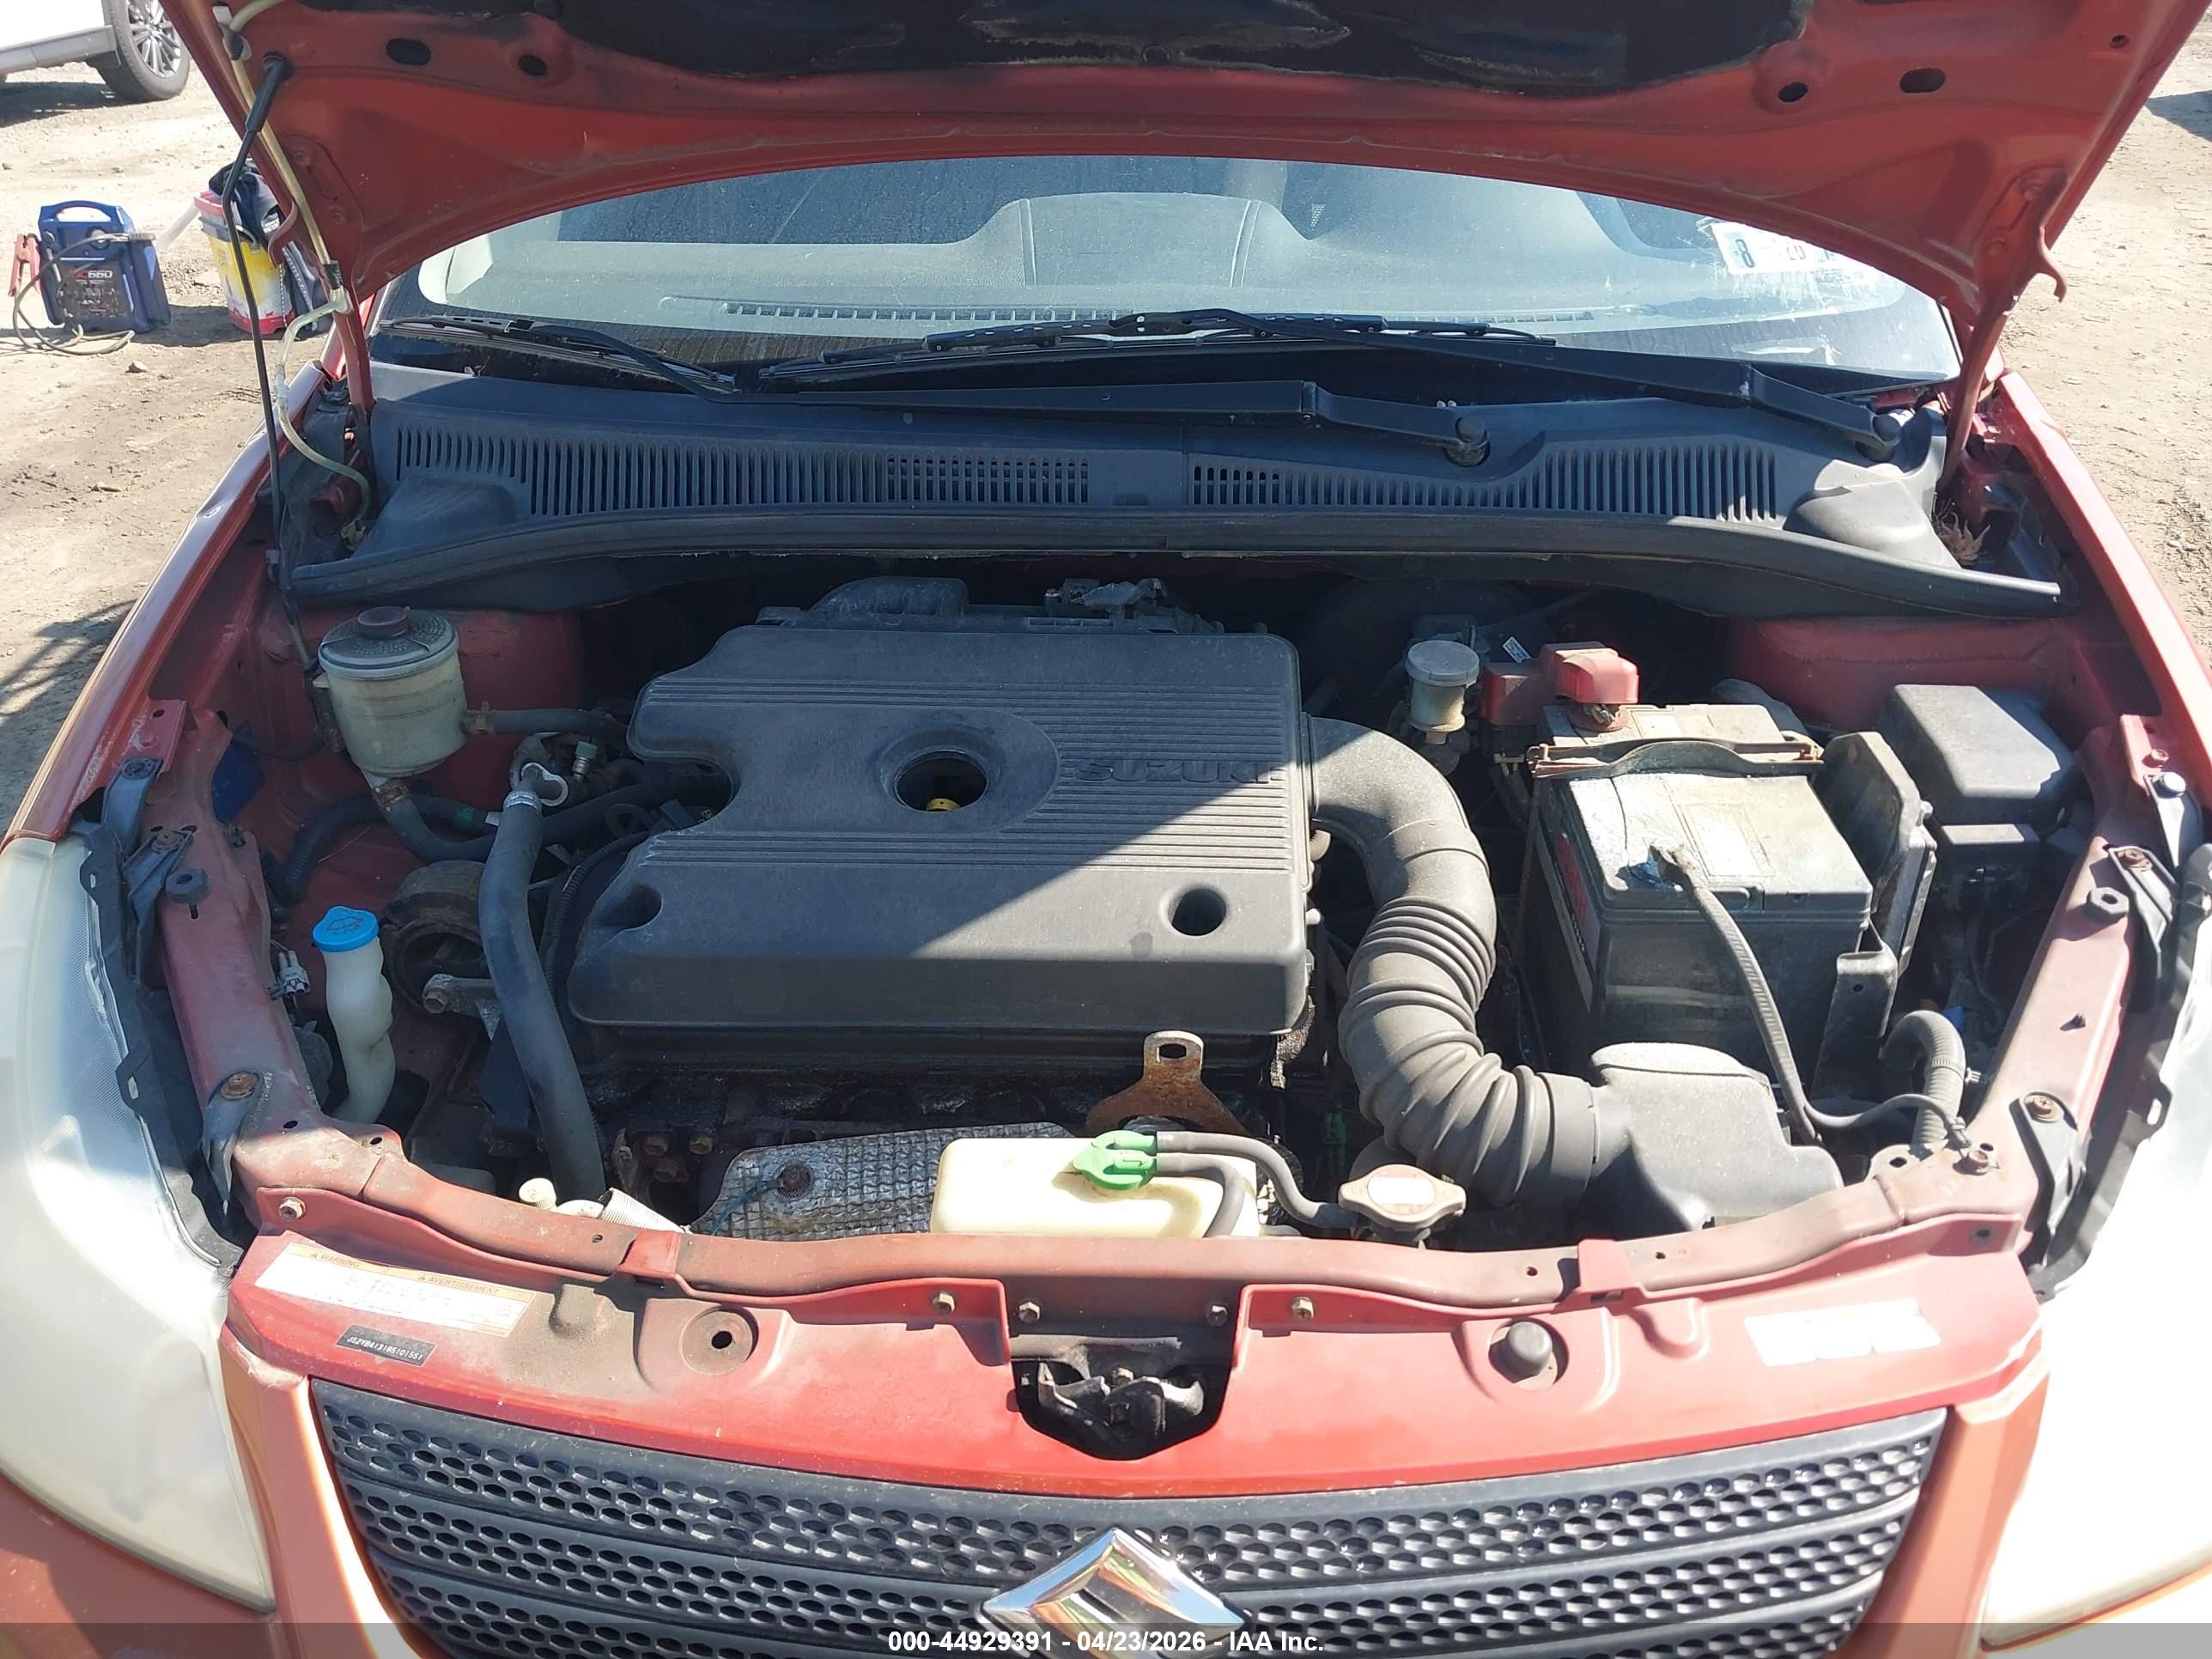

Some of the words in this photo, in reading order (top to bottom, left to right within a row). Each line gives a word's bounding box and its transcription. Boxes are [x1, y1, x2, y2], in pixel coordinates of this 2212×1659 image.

[1076, 761, 1269, 784] SUZUKI
[320, 1253, 361, 1268] WARNING
[428, 1276, 500, 1295] AVERTISSEMENT
